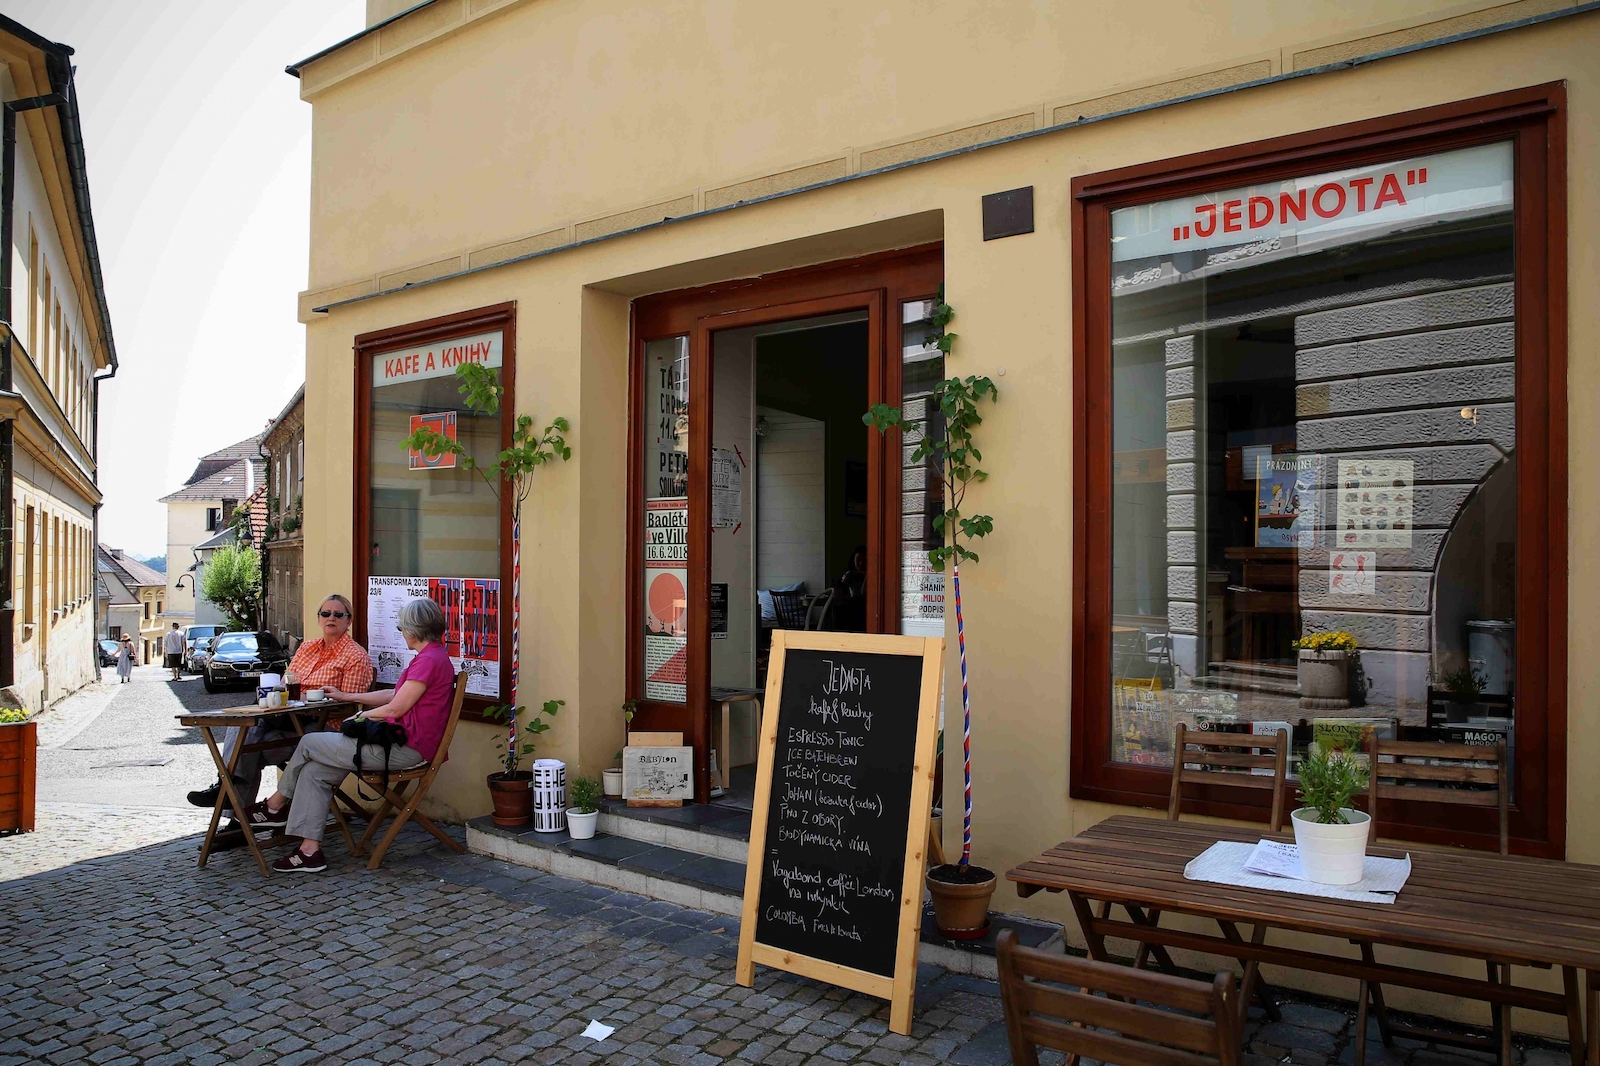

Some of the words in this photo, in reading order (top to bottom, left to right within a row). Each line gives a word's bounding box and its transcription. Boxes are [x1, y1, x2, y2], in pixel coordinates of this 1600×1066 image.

[385, 354, 420, 379] KAFE
[425, 352, 436, 372] A
[442, 340, 492, 369] KNIHY
[652, 531, 664, 544] ve
[370, 577, 412, 586] TRANSFORMA
[413, 578, 428, 587] 2018
[407, 587, 428, 597] TÁBOR
[788, 727, 834, 746] ESPRESSO
[836, 731, 865, 748] TONIC
[788, 748, 803, 761] ICE
[822, 772, 857, 789] CIDER
[782, 783, 812, 803] JOHAN
[801, 810, 809, 825] Z
[772, 859, 821, 889] Vagabond
[789, 887, 802, 899] na
